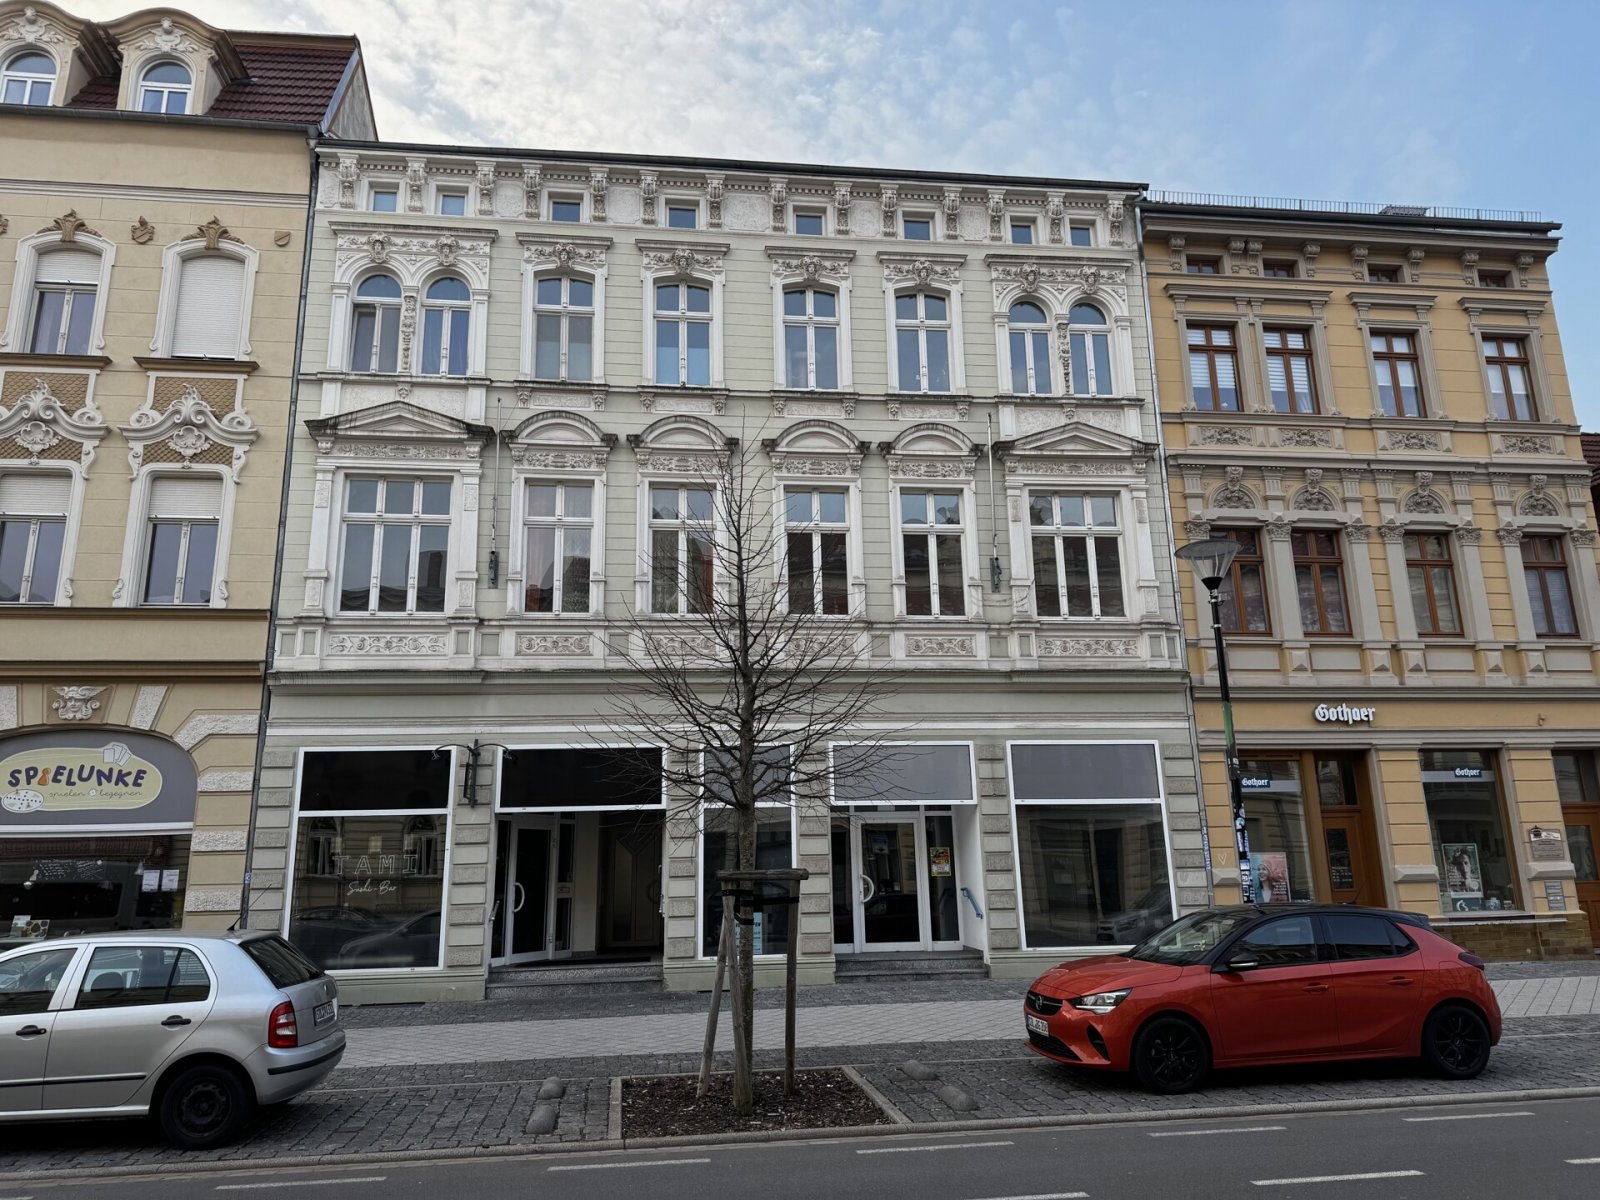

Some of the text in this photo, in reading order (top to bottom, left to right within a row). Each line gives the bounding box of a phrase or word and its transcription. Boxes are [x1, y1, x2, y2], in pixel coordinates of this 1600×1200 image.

[1315, 703, 1376, 725] Gothaer
[1455, 768, 1480, 777] Gothaer
[1242, 777, 1269, 787] Gothaer
[100, 788, 143, 799] begegnen
[332, 854, 418, 875] TAMI
